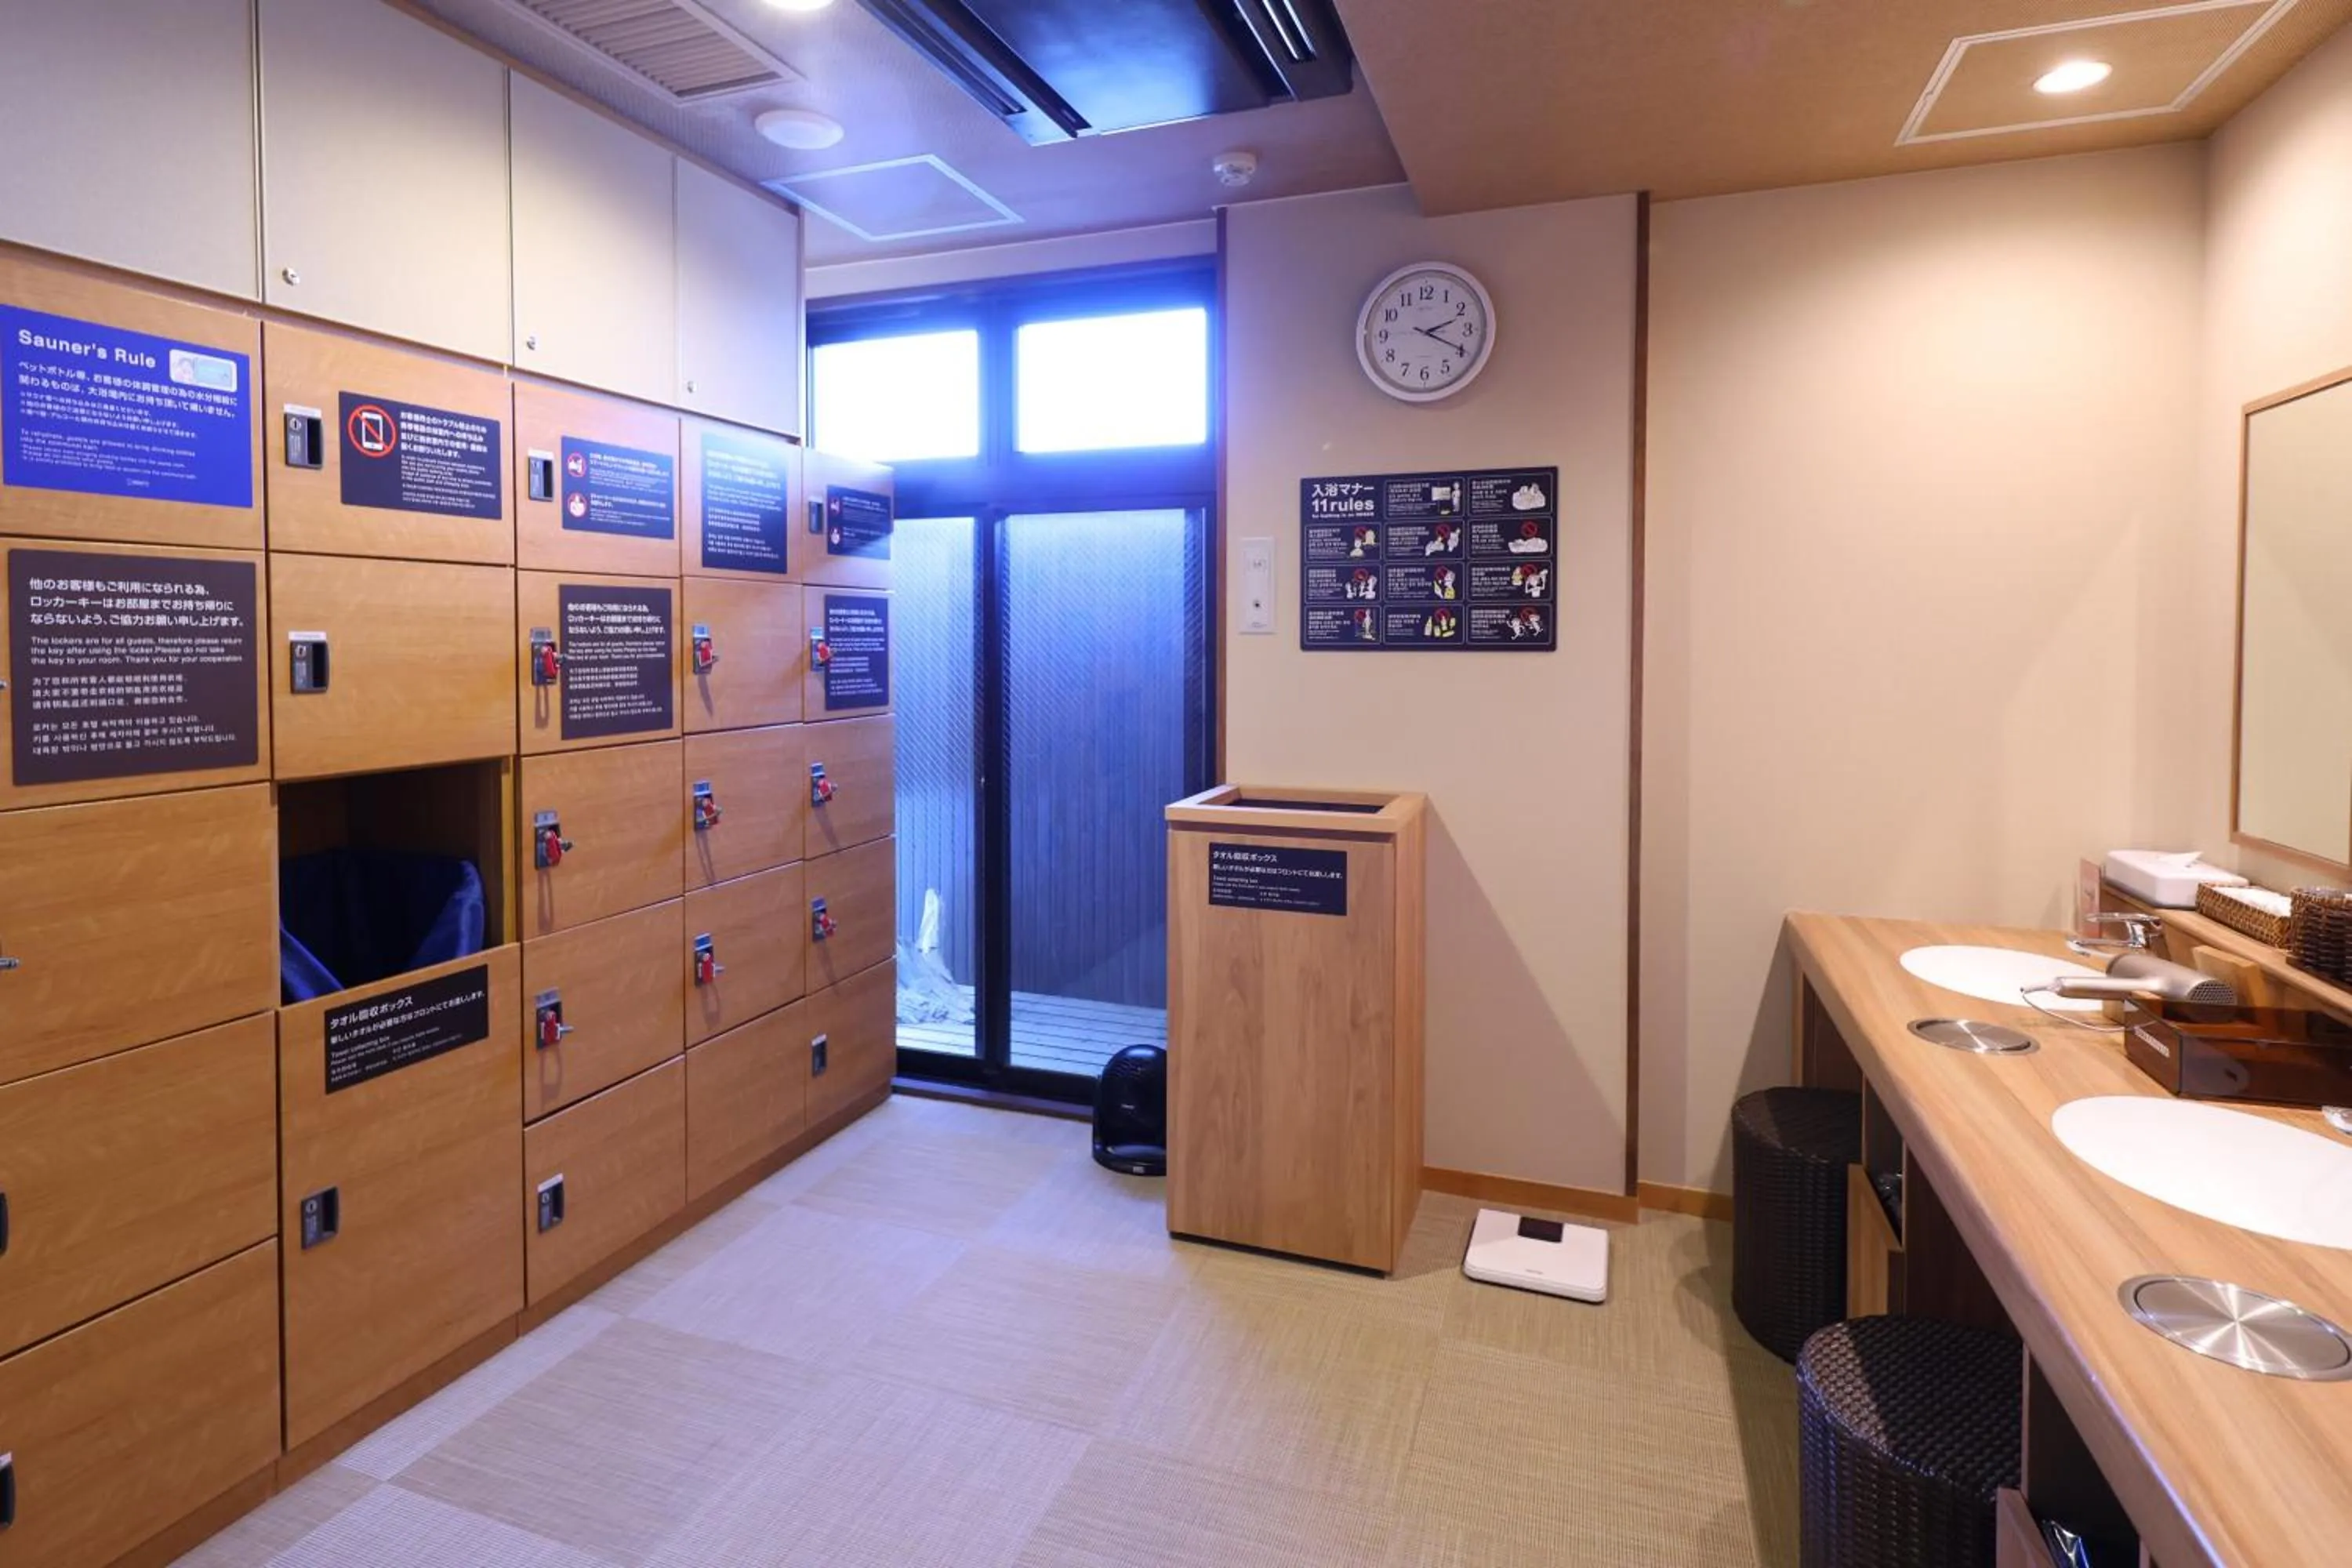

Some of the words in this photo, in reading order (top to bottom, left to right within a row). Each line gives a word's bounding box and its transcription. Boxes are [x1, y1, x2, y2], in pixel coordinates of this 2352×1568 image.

[1400, 292, 1412, 307] 11
[1420, 285, 1434, 300] 12
[1444, 290, 1449, 303] 1
[1385, 308, 1398, 322] 10
[1456, 302, 1465, 316] 2
[1379, 329, 1388, 343] 9
[1462, 322, 1473, 337] 3
[18, 328, 108, 361] Sauner's
[114, 347, 157, 369] Rule
[1385, 348, 1395, 362] 8
[1400, 362, 1410, 376] 7
[1420, 366, 1429, 381] 6
[1441, 360, 1450, 374] 5
[1312, 482, 1374, 498] 入浴マナー
[330, 996, 414, 1029] タオル回収ボックス
